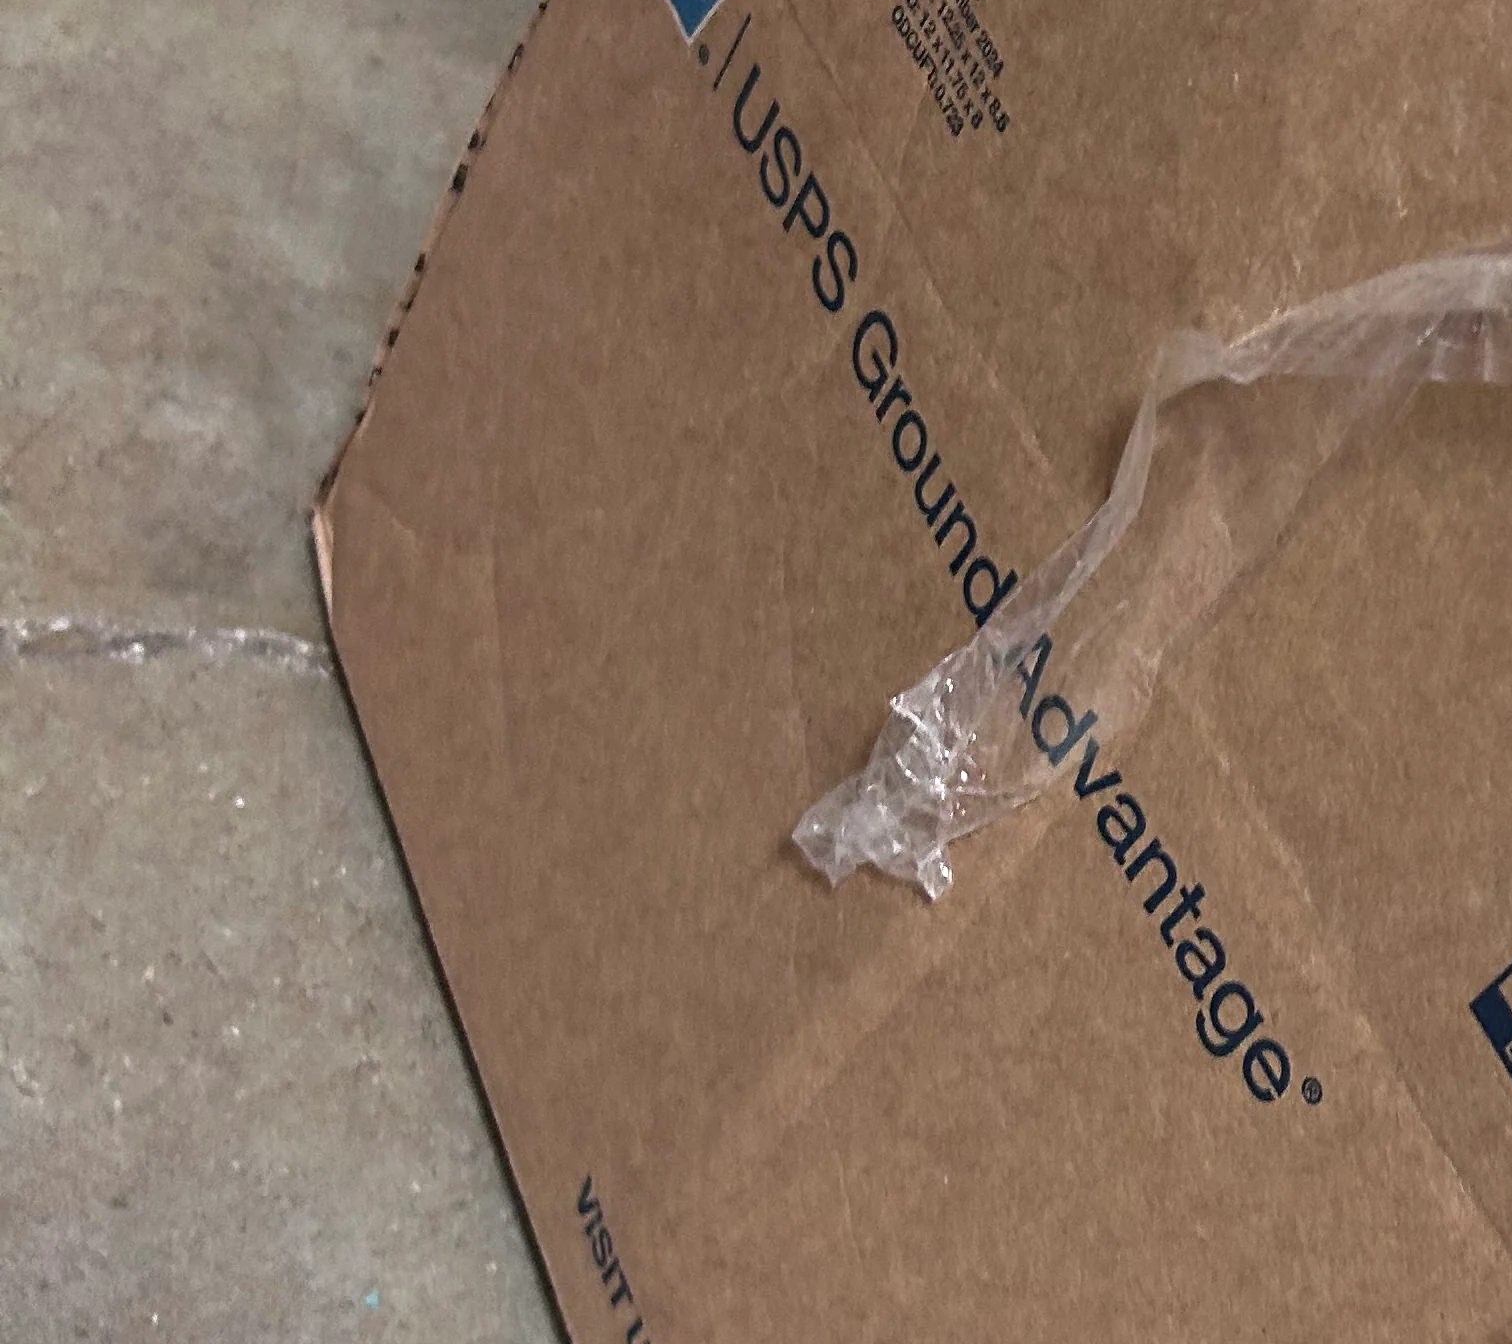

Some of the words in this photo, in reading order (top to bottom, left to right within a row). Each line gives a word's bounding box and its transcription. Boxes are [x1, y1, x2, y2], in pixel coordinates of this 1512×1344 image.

[732, 63, 858, 313] USPS
[852, 309, 1018, 630] Ground
[576, 1175, 634, 1309] VISIT
